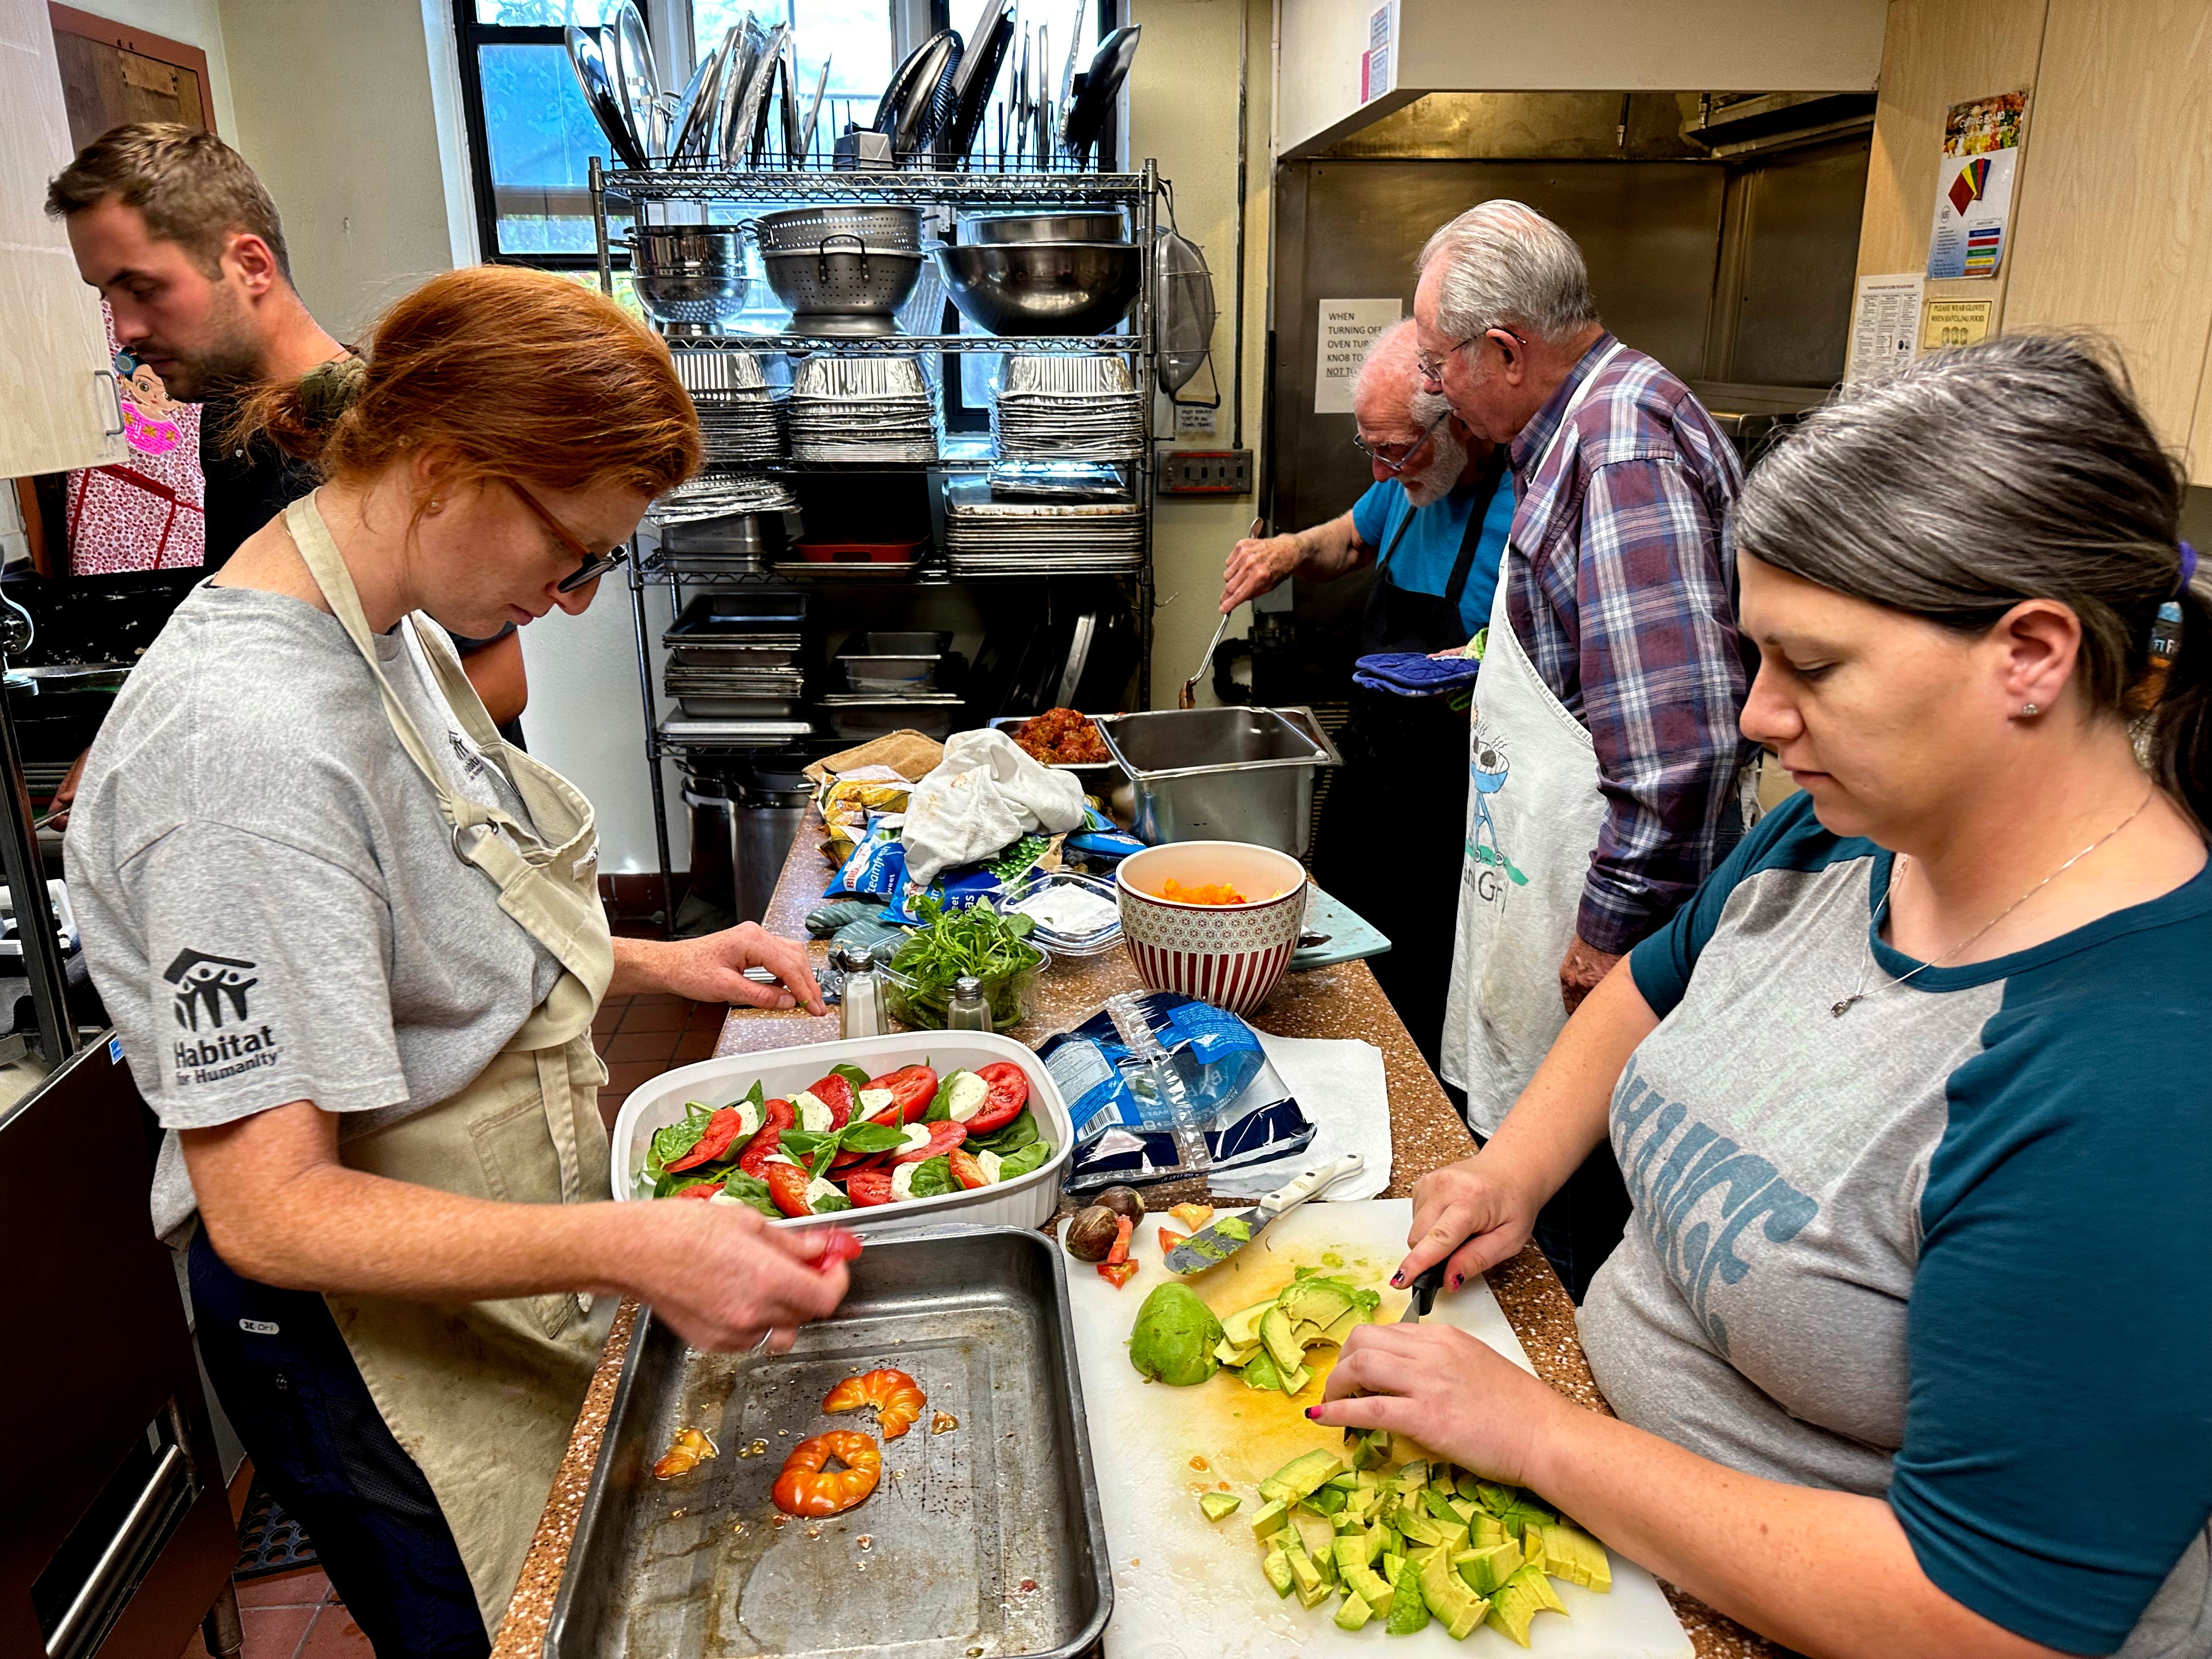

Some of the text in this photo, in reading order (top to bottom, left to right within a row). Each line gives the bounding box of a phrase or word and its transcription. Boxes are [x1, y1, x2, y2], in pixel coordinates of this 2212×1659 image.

[1328, 326, 1365, 335] TURNING
[1327, 354, 1350, 362] KNOB
[1327, 368, 1344, 376] NOT
[864, 846, 891, 893] teamfresh
[887, 874, 895, 894] weet
[964, 895, 975, 915] eas
[174, 1025, 274, 1068] Habitat
[177, 1052, 277, 1086] for Humanity
